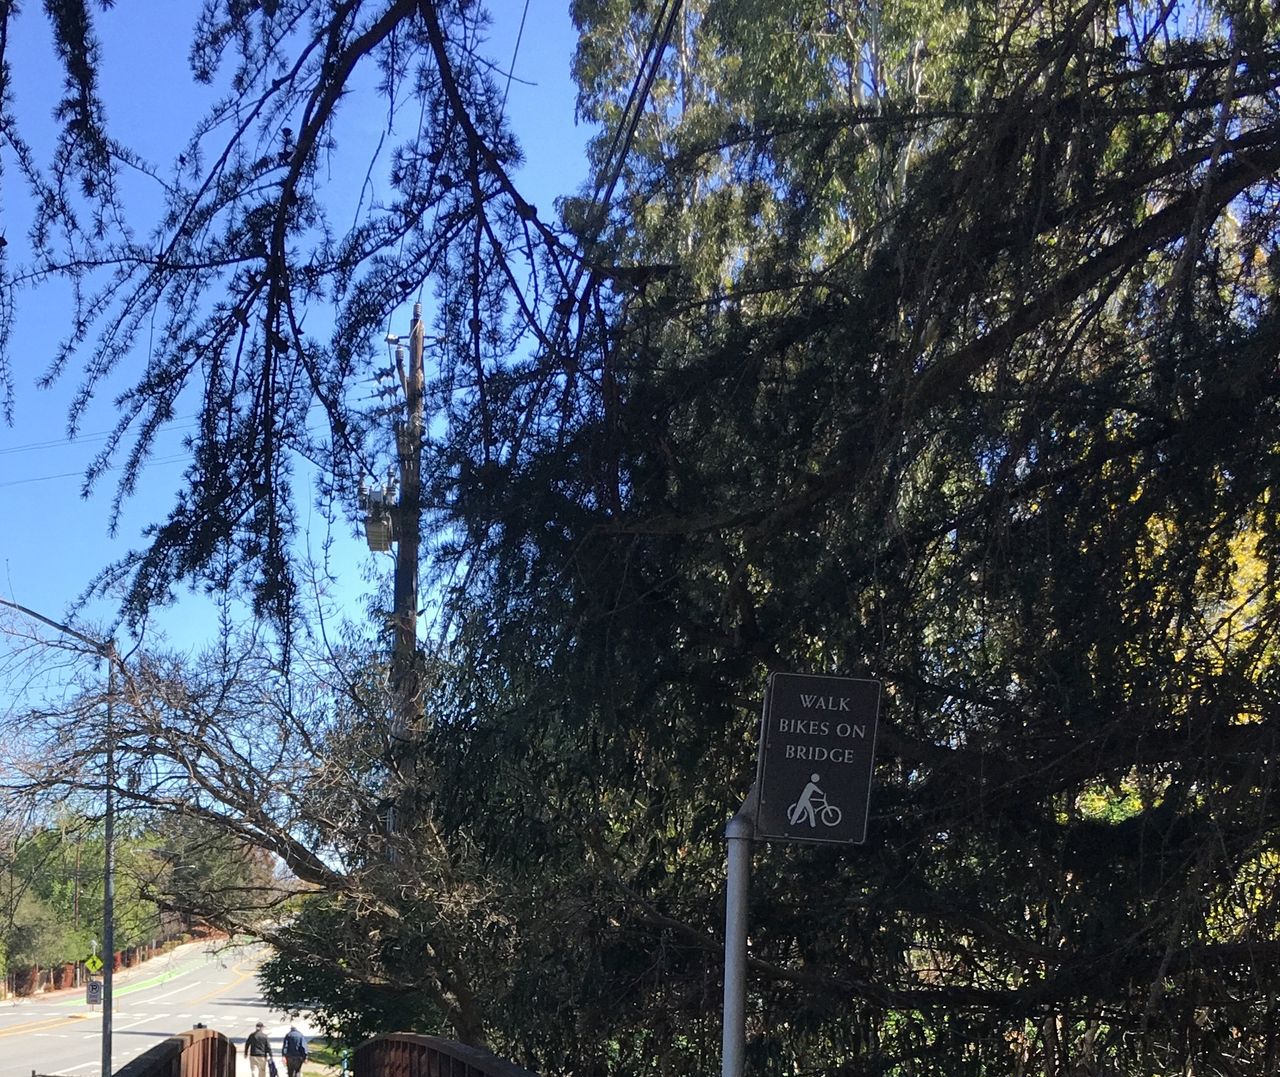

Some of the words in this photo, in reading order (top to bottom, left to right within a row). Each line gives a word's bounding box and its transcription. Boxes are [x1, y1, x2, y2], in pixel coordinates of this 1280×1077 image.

[800, 694, 851, 712] WALK
[778, 718, 829, 736] BIKES
[836, 723, 867, 739] ON
[785, 745, 854, 764] BRIDGE
